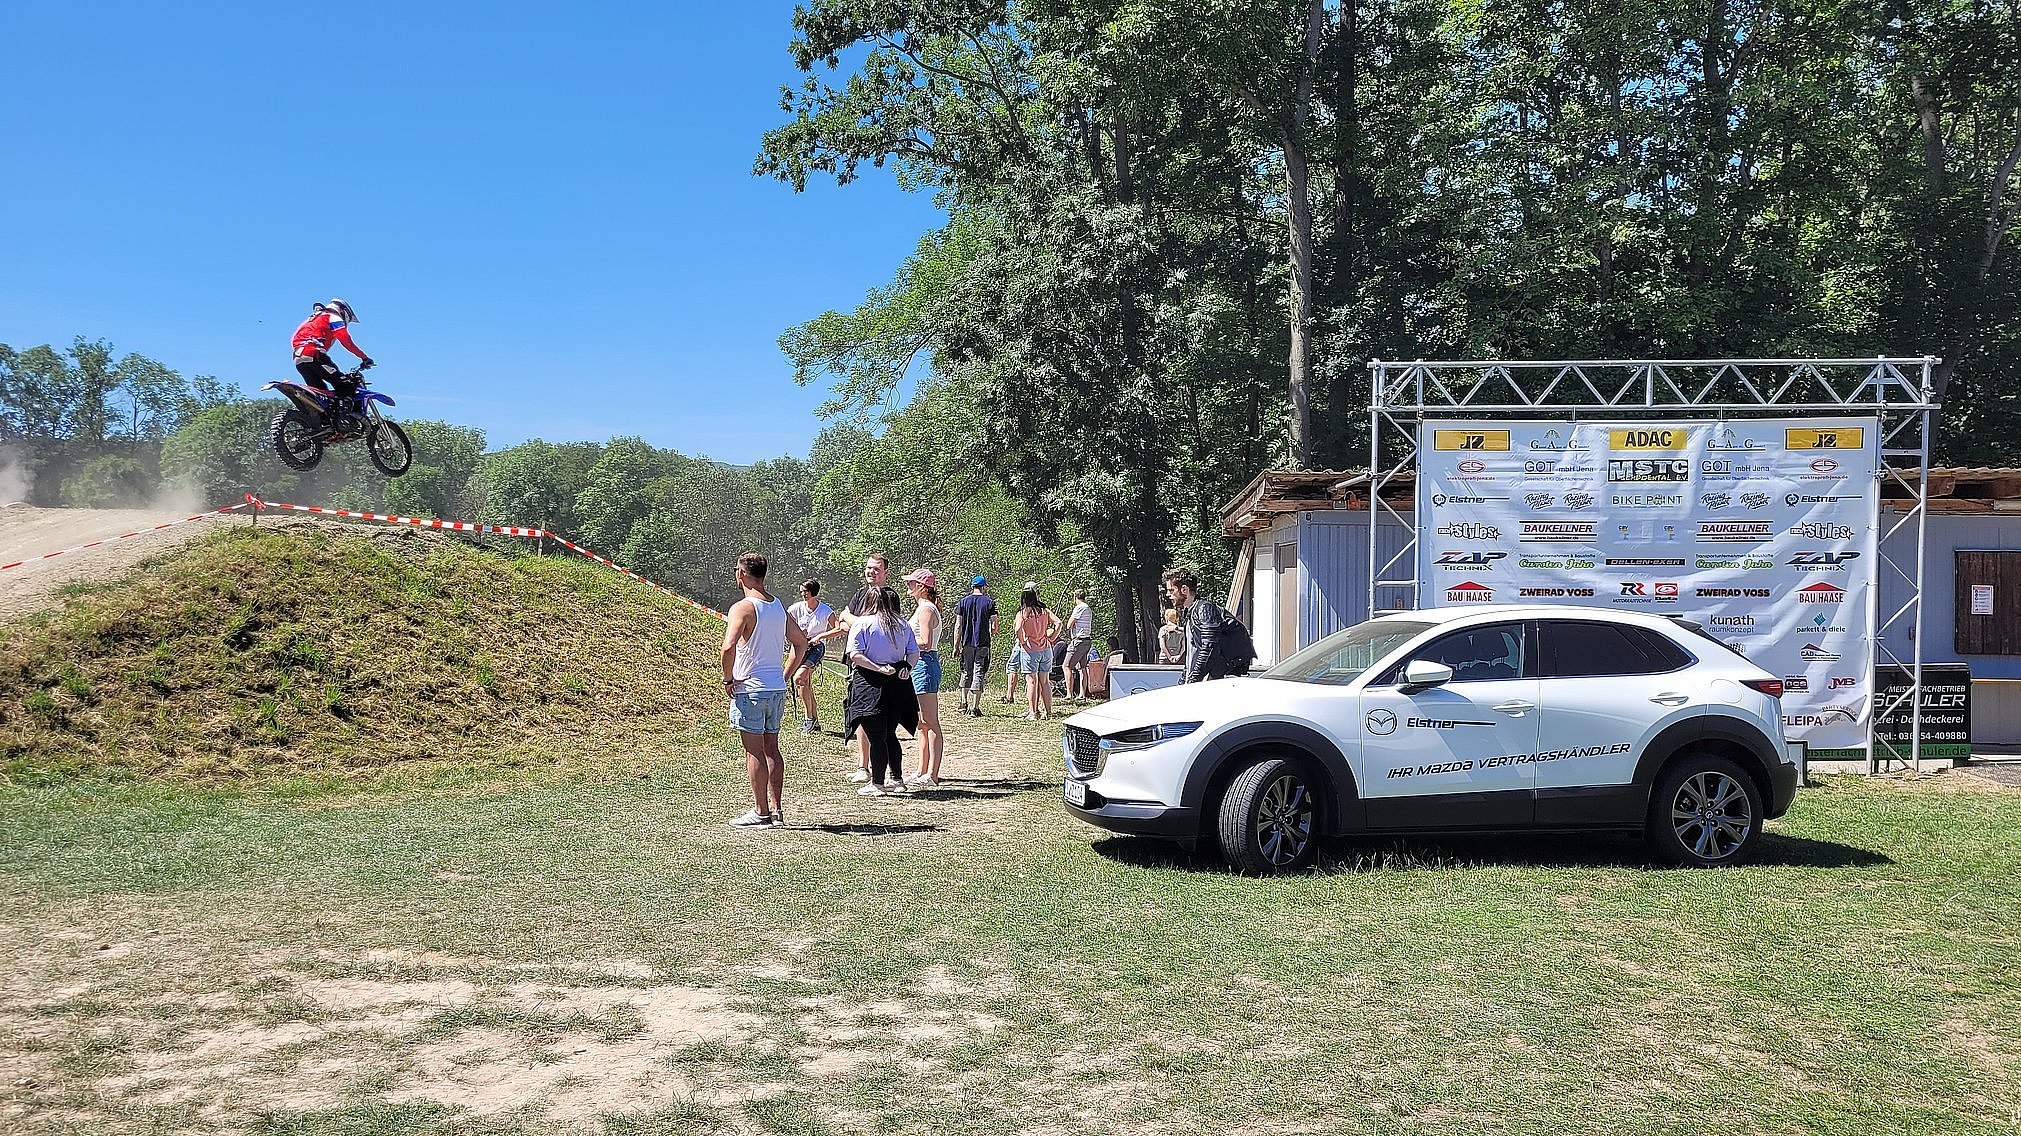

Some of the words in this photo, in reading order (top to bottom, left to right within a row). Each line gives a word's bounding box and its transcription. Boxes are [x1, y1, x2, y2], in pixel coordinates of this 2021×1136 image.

[1625, 431, 1672, 447] ADAC
[1525, 460, 1555, 472] GOT
[1608, 461, 1688, 480] MSTC
[1702, 460, 1732, 472] GOT
[1448, 495, 1486, 503] Elstner
[1524, 493, 1555, 504] Racing
[1563, 493, 1594, 504] Racing
[1612, 495, 1641, 504] BIKE
[1701, 493, 1732, 504] Racing
[1740, 493, 1771, 504] Racing
[1800, 495, 1839, 503] Elstner
[1454, 523, 1496, 539] styles
[1523, 524, 1593, 532] BAUKELLNER
[1701, 524, 1769, 532] BAUKELLNER
[1807, 523, 1850, 540] styles
[1432, 552, 1508, 564] ZAP
[1519, 558, 1563, 569] Carsten
[1696, 558, 1740, 569] Carsten
[1786, 552, 1861, 564] ZAP
[1447, 592, 1463, 602] BAU
[1466, 592, 1492, 602] HAASE
[1519, 588, 1565, 597] ZWEIRAD
[1566, 588, 1594, 597] VOSS
[1695, 588, 1741, 597] ZWEIRAD
[1743, 588, 1770, 597] VOSS
[1799, 592, 1816, 603] BAU
[1818, 592, 1844, 603] HAASE
[1710, 614, 1755, 626] kunath
[1708, 625, 1754, 634] raumkonzept
[1796, 626, 1820, 634] parkett
[1407, 717, 1455, 729] Elstner
[1900, 714, 1965, 724] Dahdeckerei
[1898, 731, 1967, 741] 03654-409880
[1386, 767, 1413, 779] IHR
[1478, 743, 1631, 769] VERTRAGSHÄNDLER
